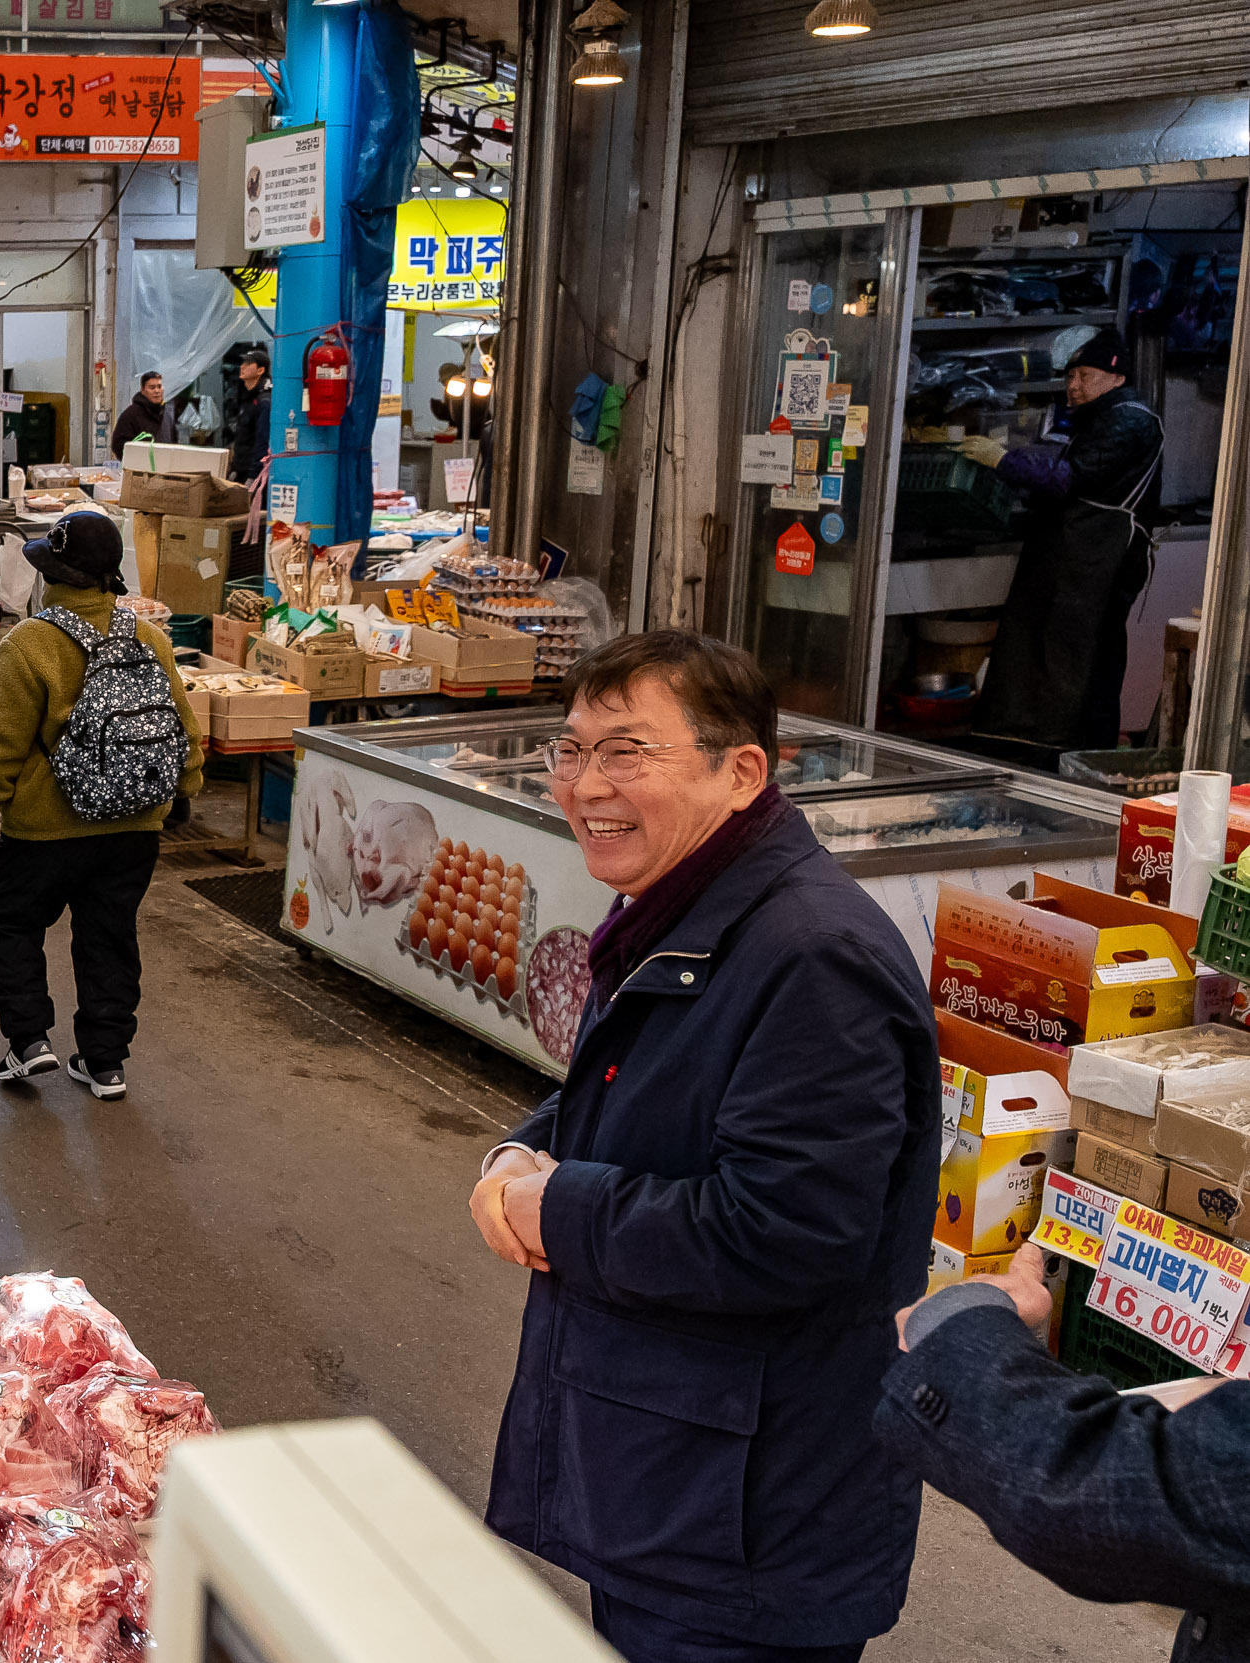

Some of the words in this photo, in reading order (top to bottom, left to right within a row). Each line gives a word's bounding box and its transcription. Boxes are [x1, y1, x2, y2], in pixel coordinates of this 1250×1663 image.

[94, 139, 175, 152] 010-75828658
[409, 236, 439, 276] 막
[940, 977, 1067, 1042] 삼부자고구마
[1055, 1193, 1104, 1235] 디포리
[1108, 1231, 1208, 1304] 고바멸치
[1218, 1274, 1241, 1293] 국내산
[1174, 1224, 1247, 1277] 청과세일
[1096, 1276, 1208, 1356] 16,000
[1201, 1299, 1229, 1328] 1박스
